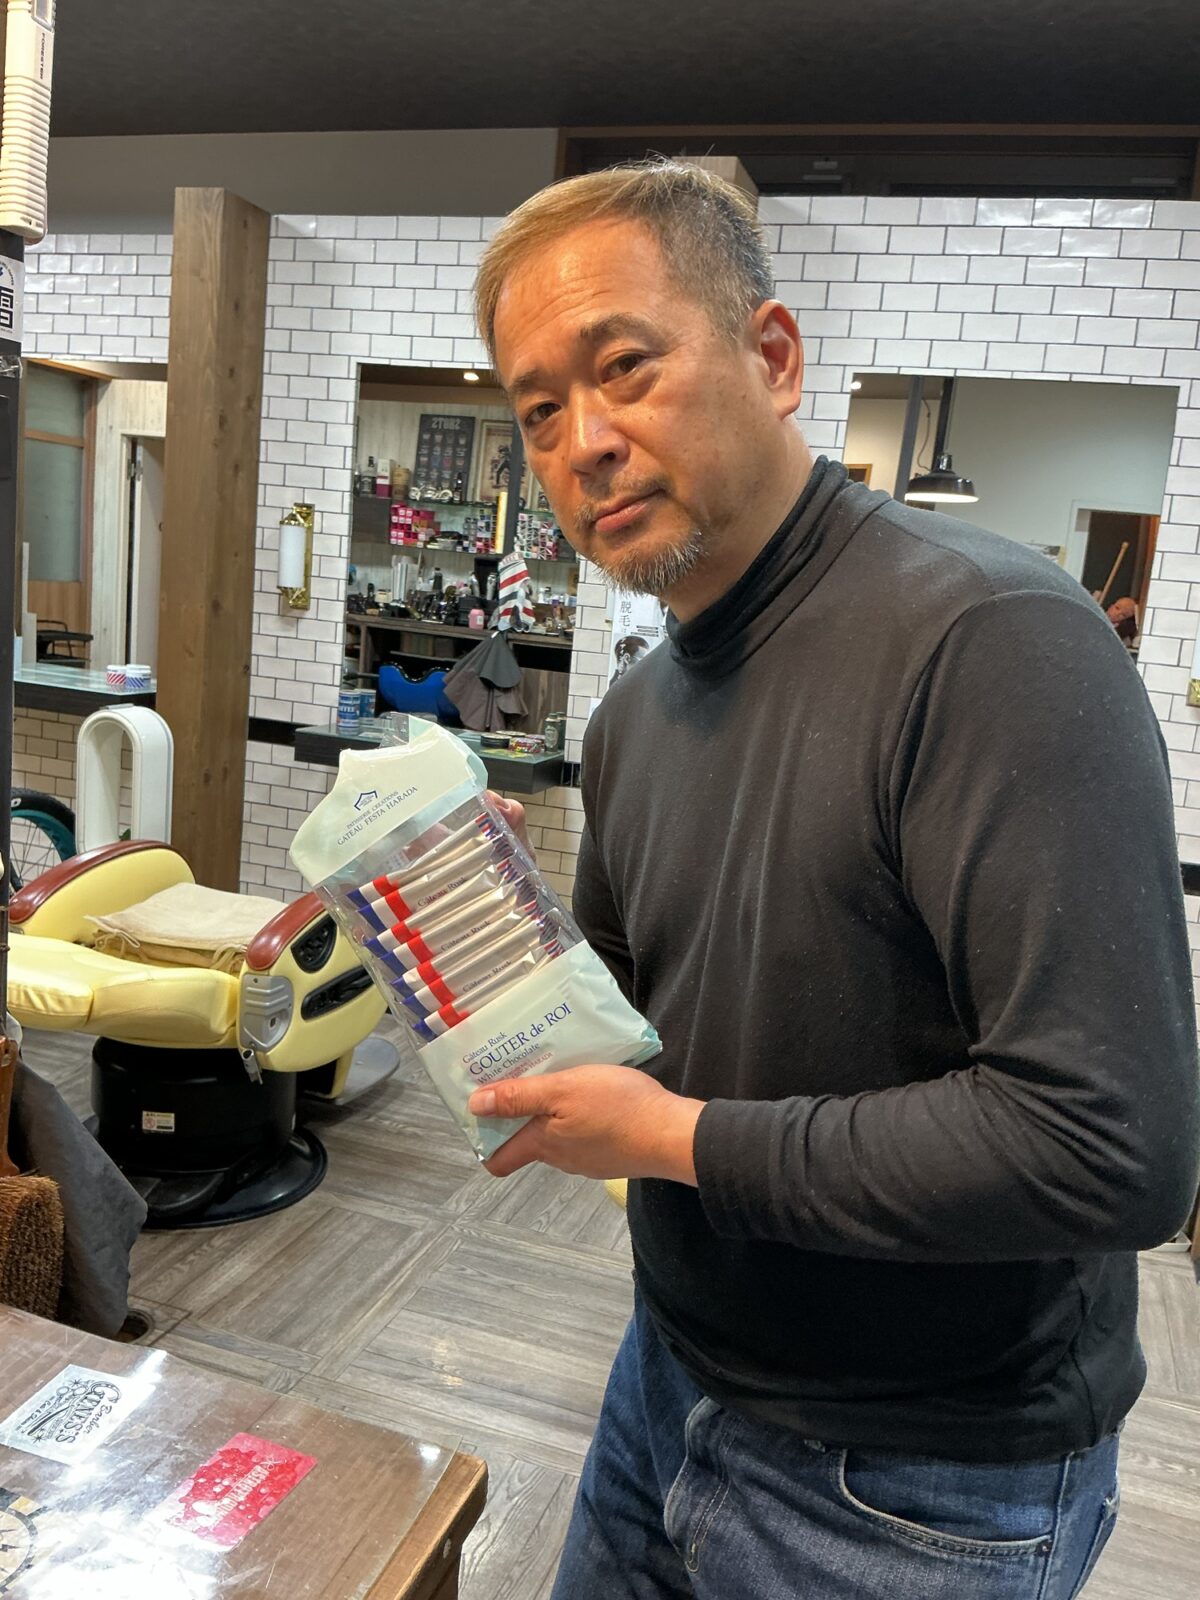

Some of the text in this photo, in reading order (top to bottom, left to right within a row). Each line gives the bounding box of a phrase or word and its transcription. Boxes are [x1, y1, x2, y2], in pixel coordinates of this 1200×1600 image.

[337, 824, 364, 846] GATEAU
[364, 808, 386, 826] FESTA
[386, 786, 418, 810] HARADA
[469, 1031, 530, 1075] GOUTER
[529, 1023, 546, 1038] de
[544, 1002, 572, 1027] ROI
[488, 1031, 508, 1047] Rusk
[476, 1067, 501, 1085] White
[502, 1043, 540, 1069] Chocolate
[83, 1404, 113, 1434] Barber
